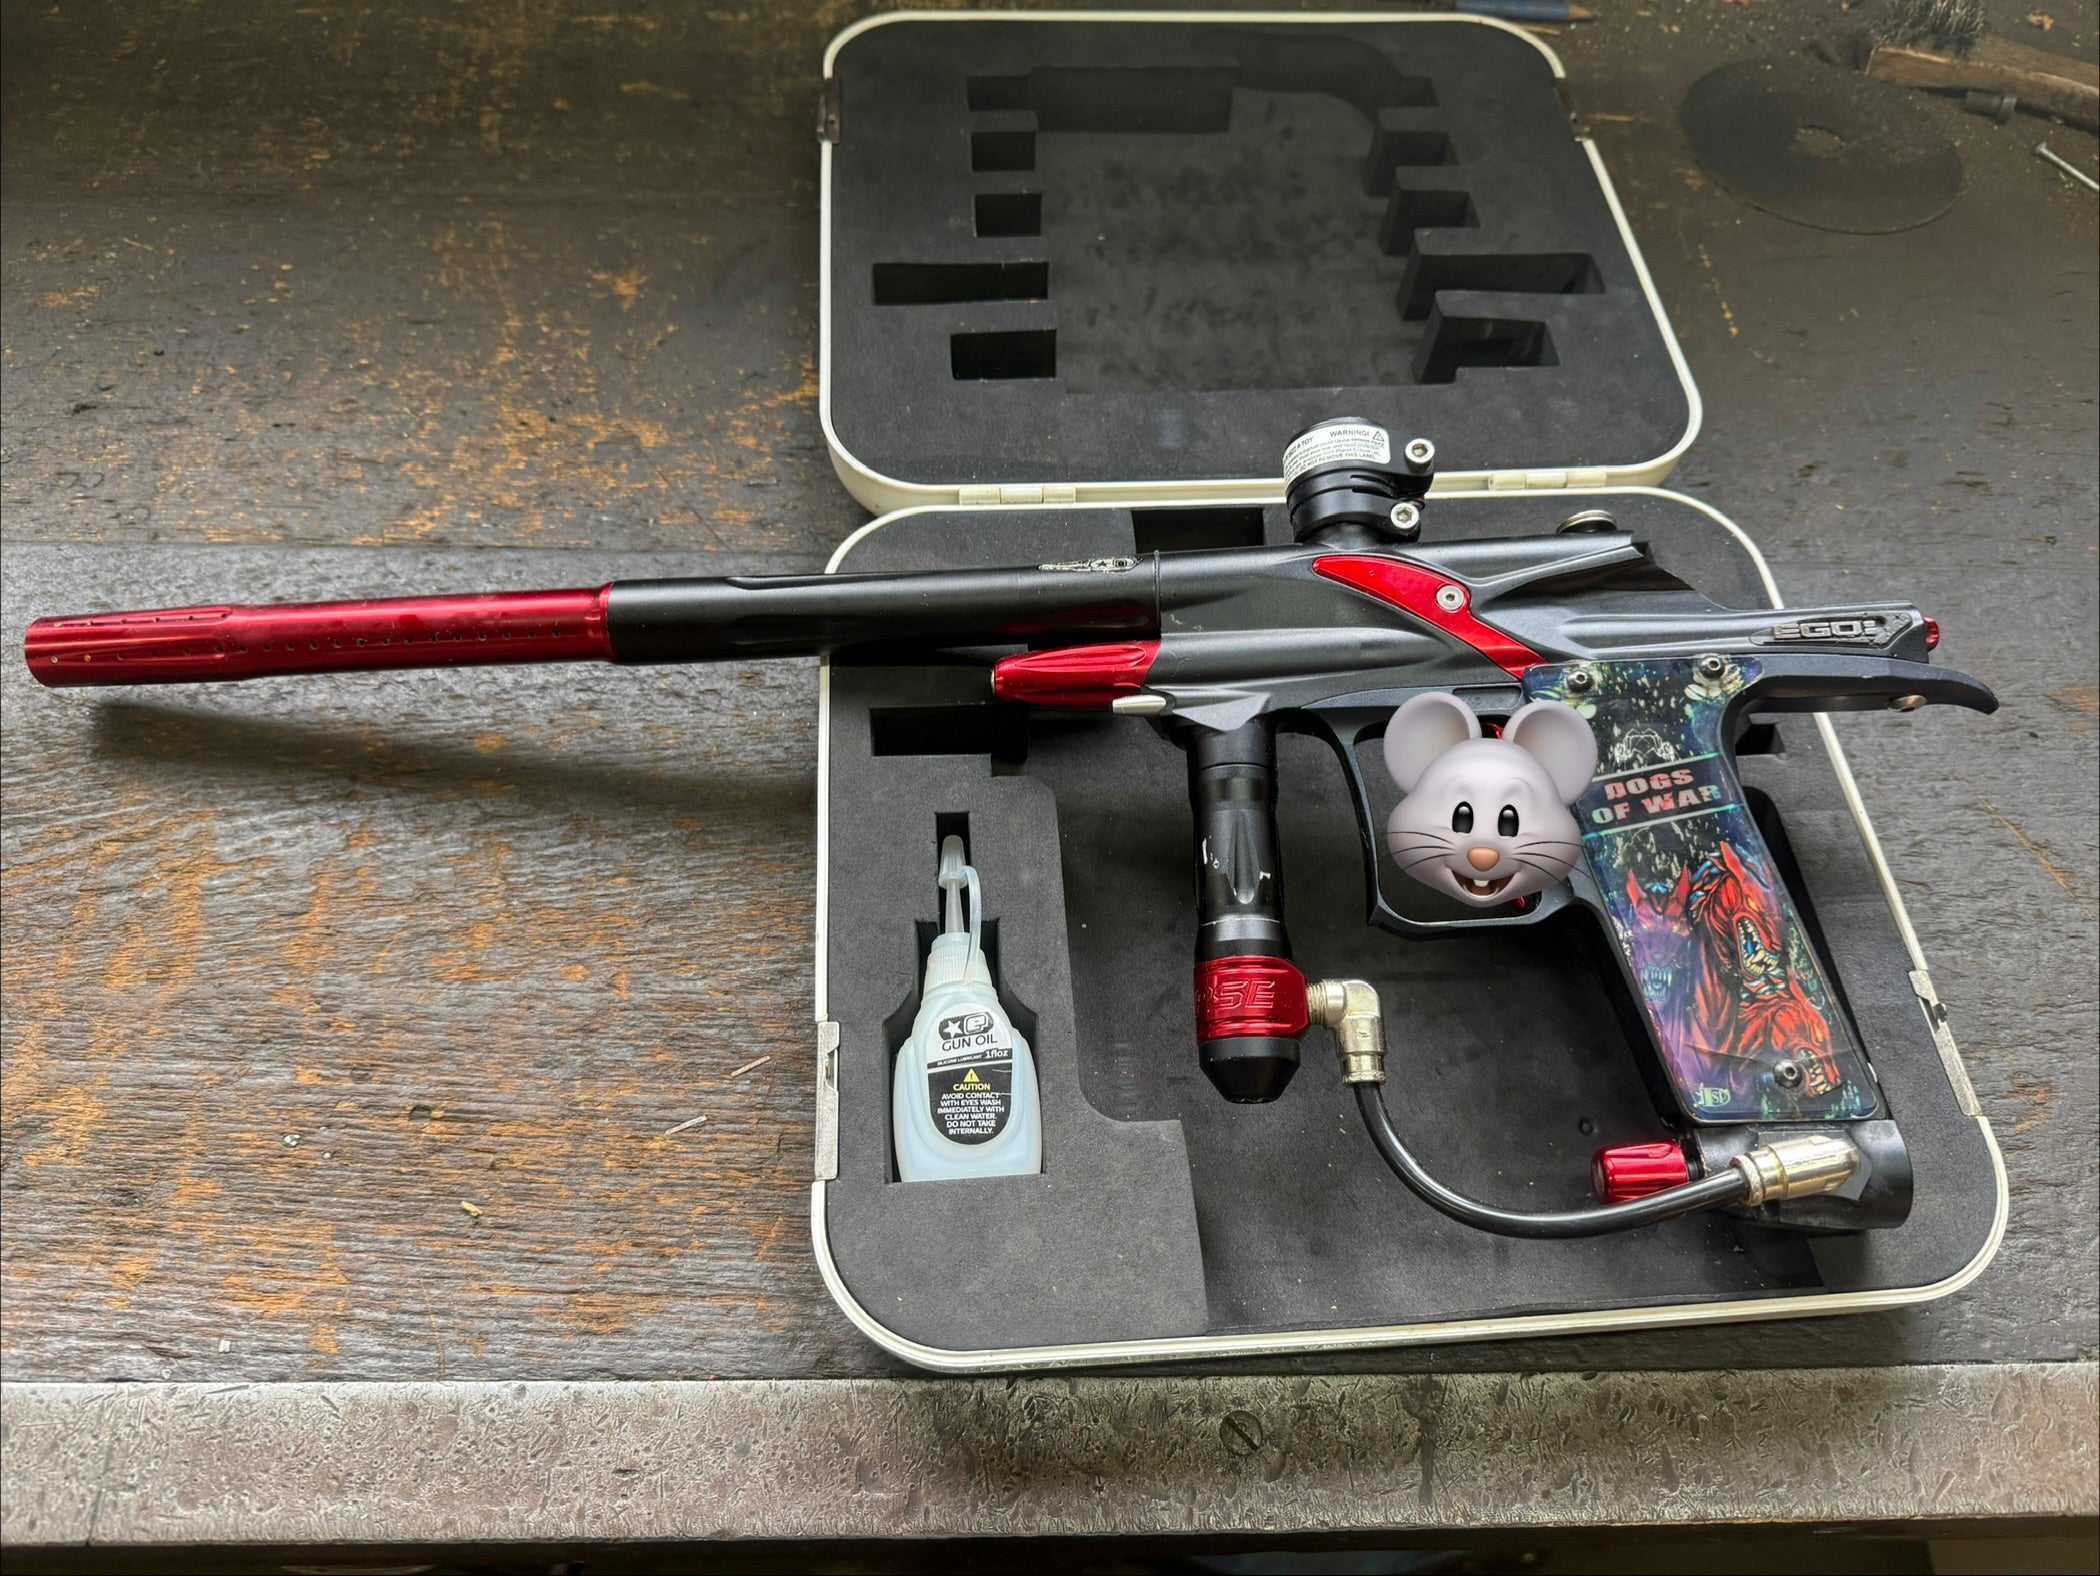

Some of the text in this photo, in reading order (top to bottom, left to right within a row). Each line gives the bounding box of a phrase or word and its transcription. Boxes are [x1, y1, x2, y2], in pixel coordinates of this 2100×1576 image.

[1329, 429, 1370, 437] WARNING!
[1604, 769, 1694, 800] DOGS
[1591, 784, 1721, 824] OF WAR
[942, 1034, 998, 1051] GUN OIL
[952, 1083, 991, 1091] CAUTION
[941, 1092, 964, 1100] AVOID
[937, 1106, 984, 1114] IMMEDIATELY
[948, 1127, 994, 1135] INTERNALLY.
